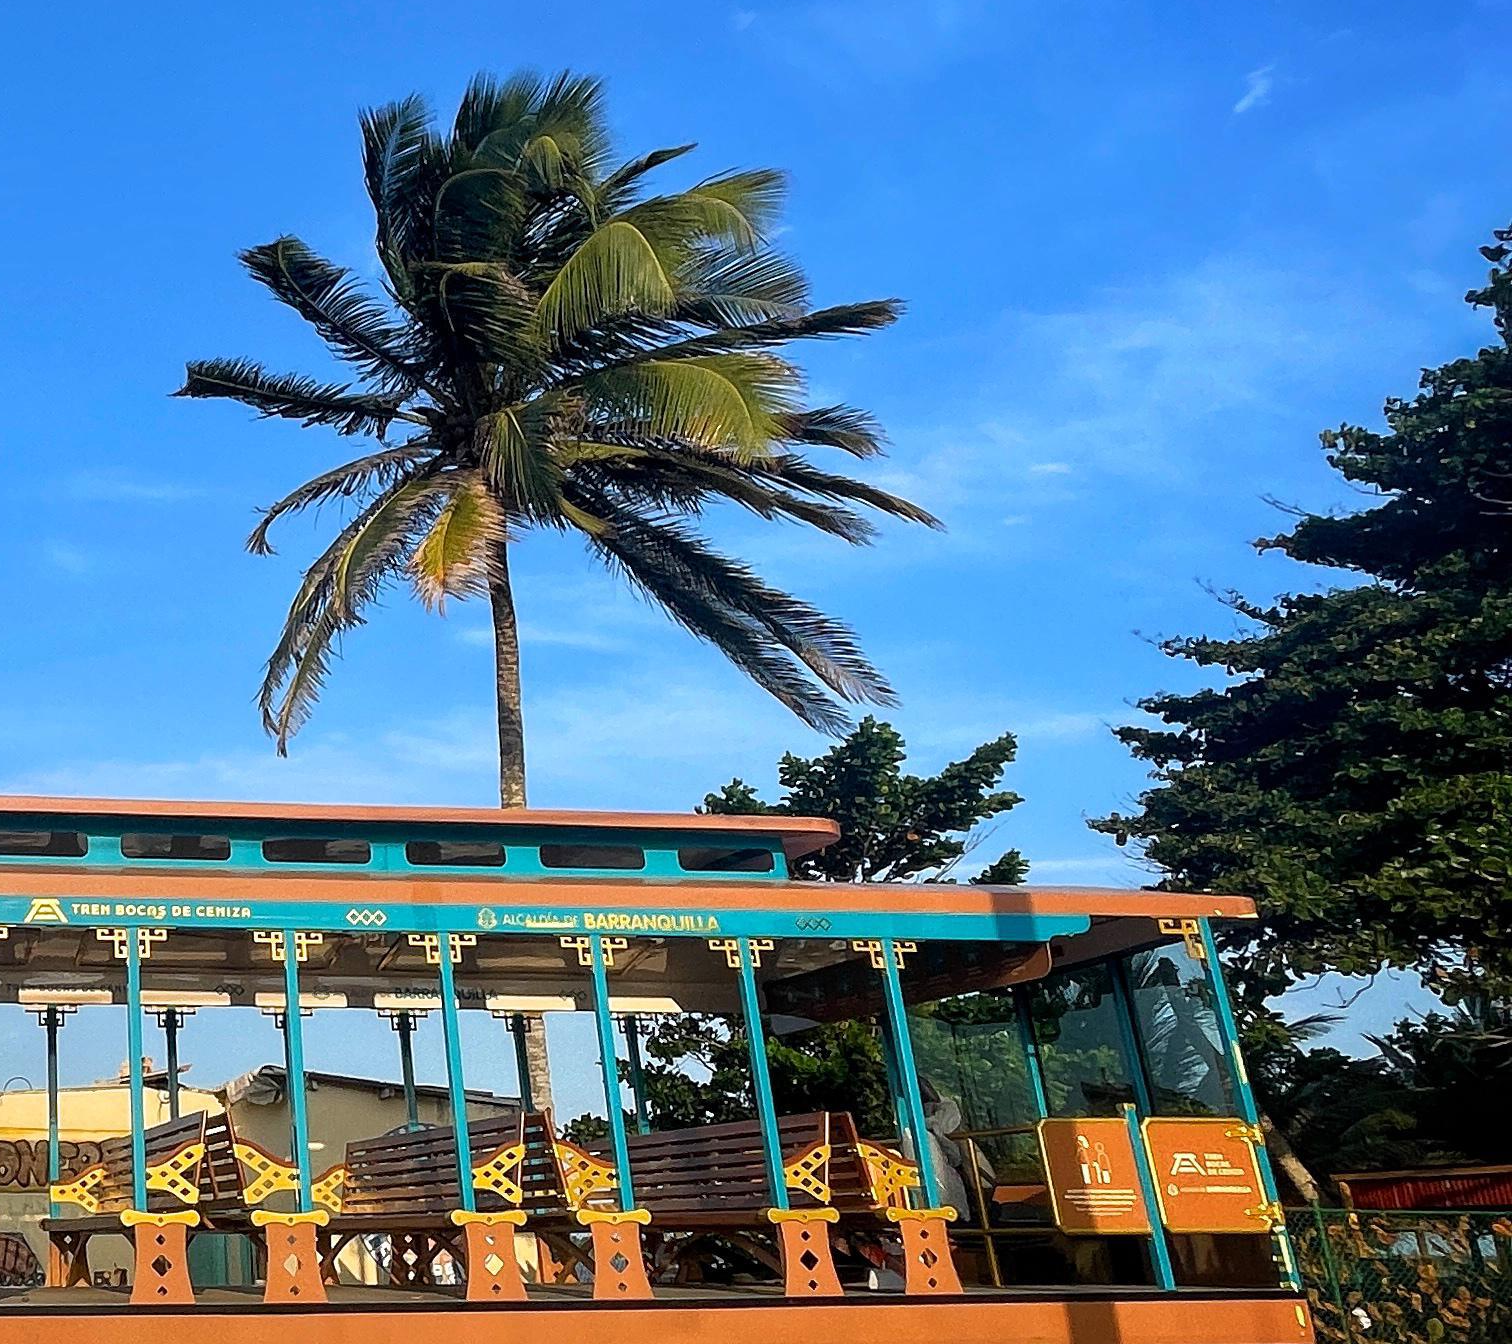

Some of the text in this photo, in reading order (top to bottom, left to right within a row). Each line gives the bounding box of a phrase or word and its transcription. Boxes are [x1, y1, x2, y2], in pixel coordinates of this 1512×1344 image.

[115, 904, 167, 918] BOCAS
[171, 905, 192, 917] DE
[584, 912, 720, 931] BARRANQUILLA
